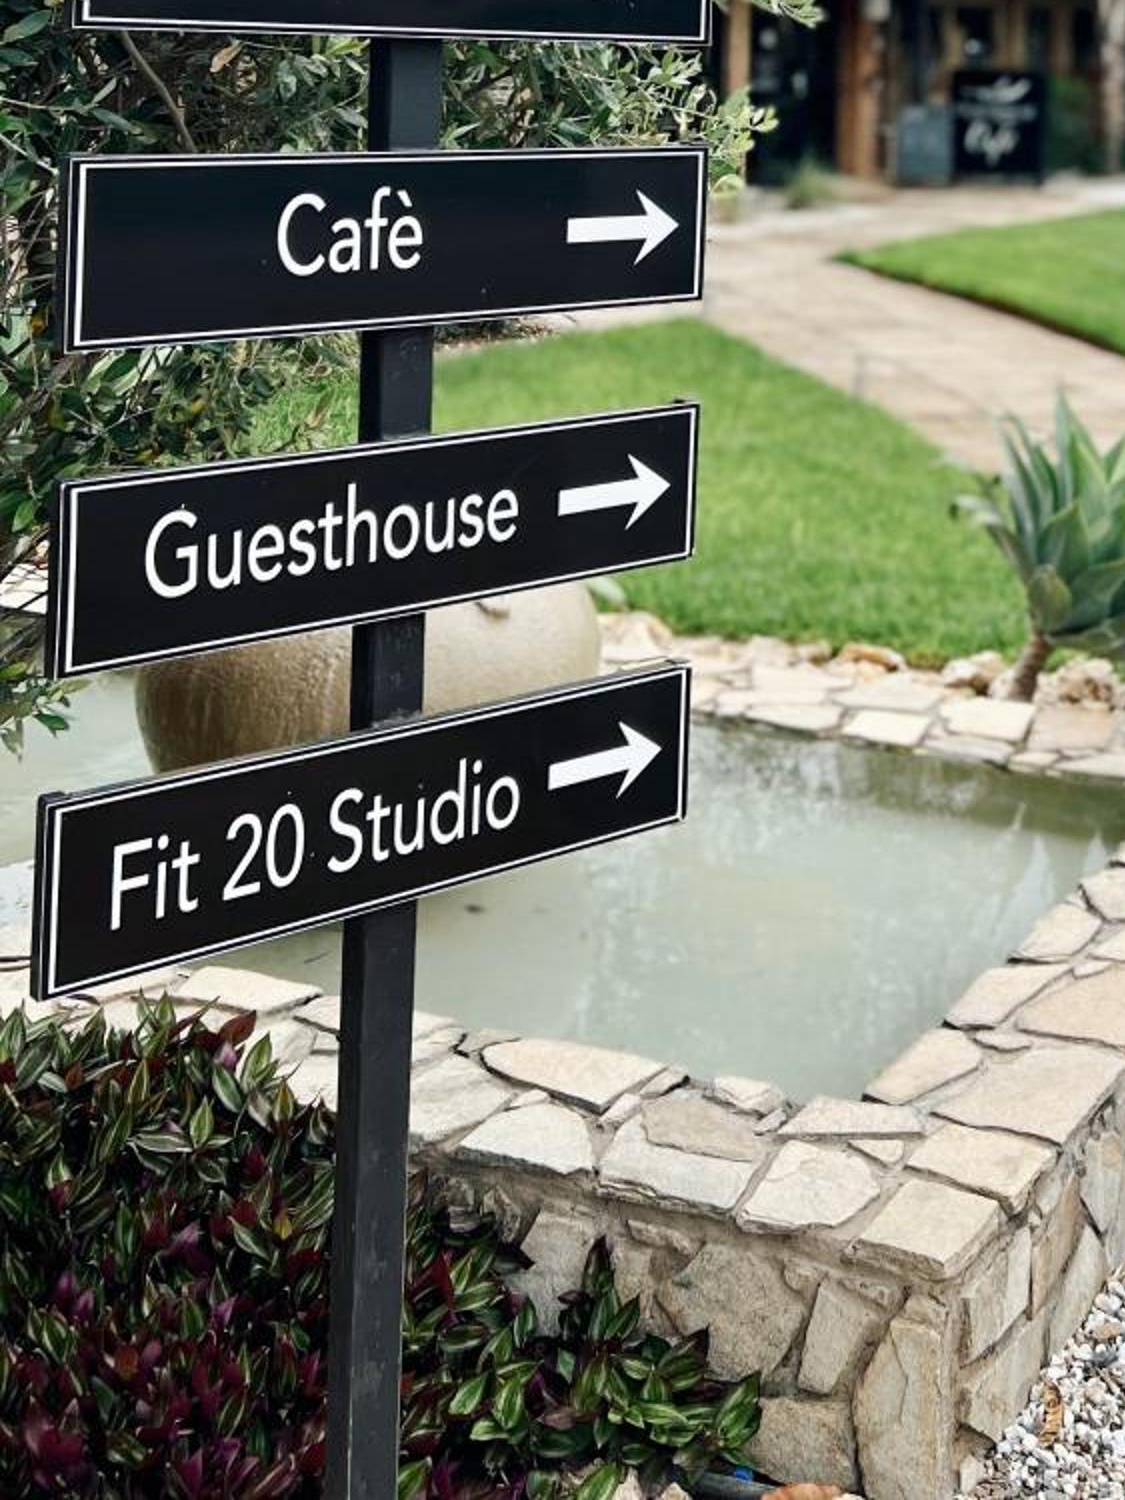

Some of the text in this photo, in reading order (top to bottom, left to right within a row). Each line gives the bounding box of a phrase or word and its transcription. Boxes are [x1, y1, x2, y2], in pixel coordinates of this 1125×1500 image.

[144, 483, 519, 599] Guesthouse
[110, 758, 521, 931] Fit 20 Studio
